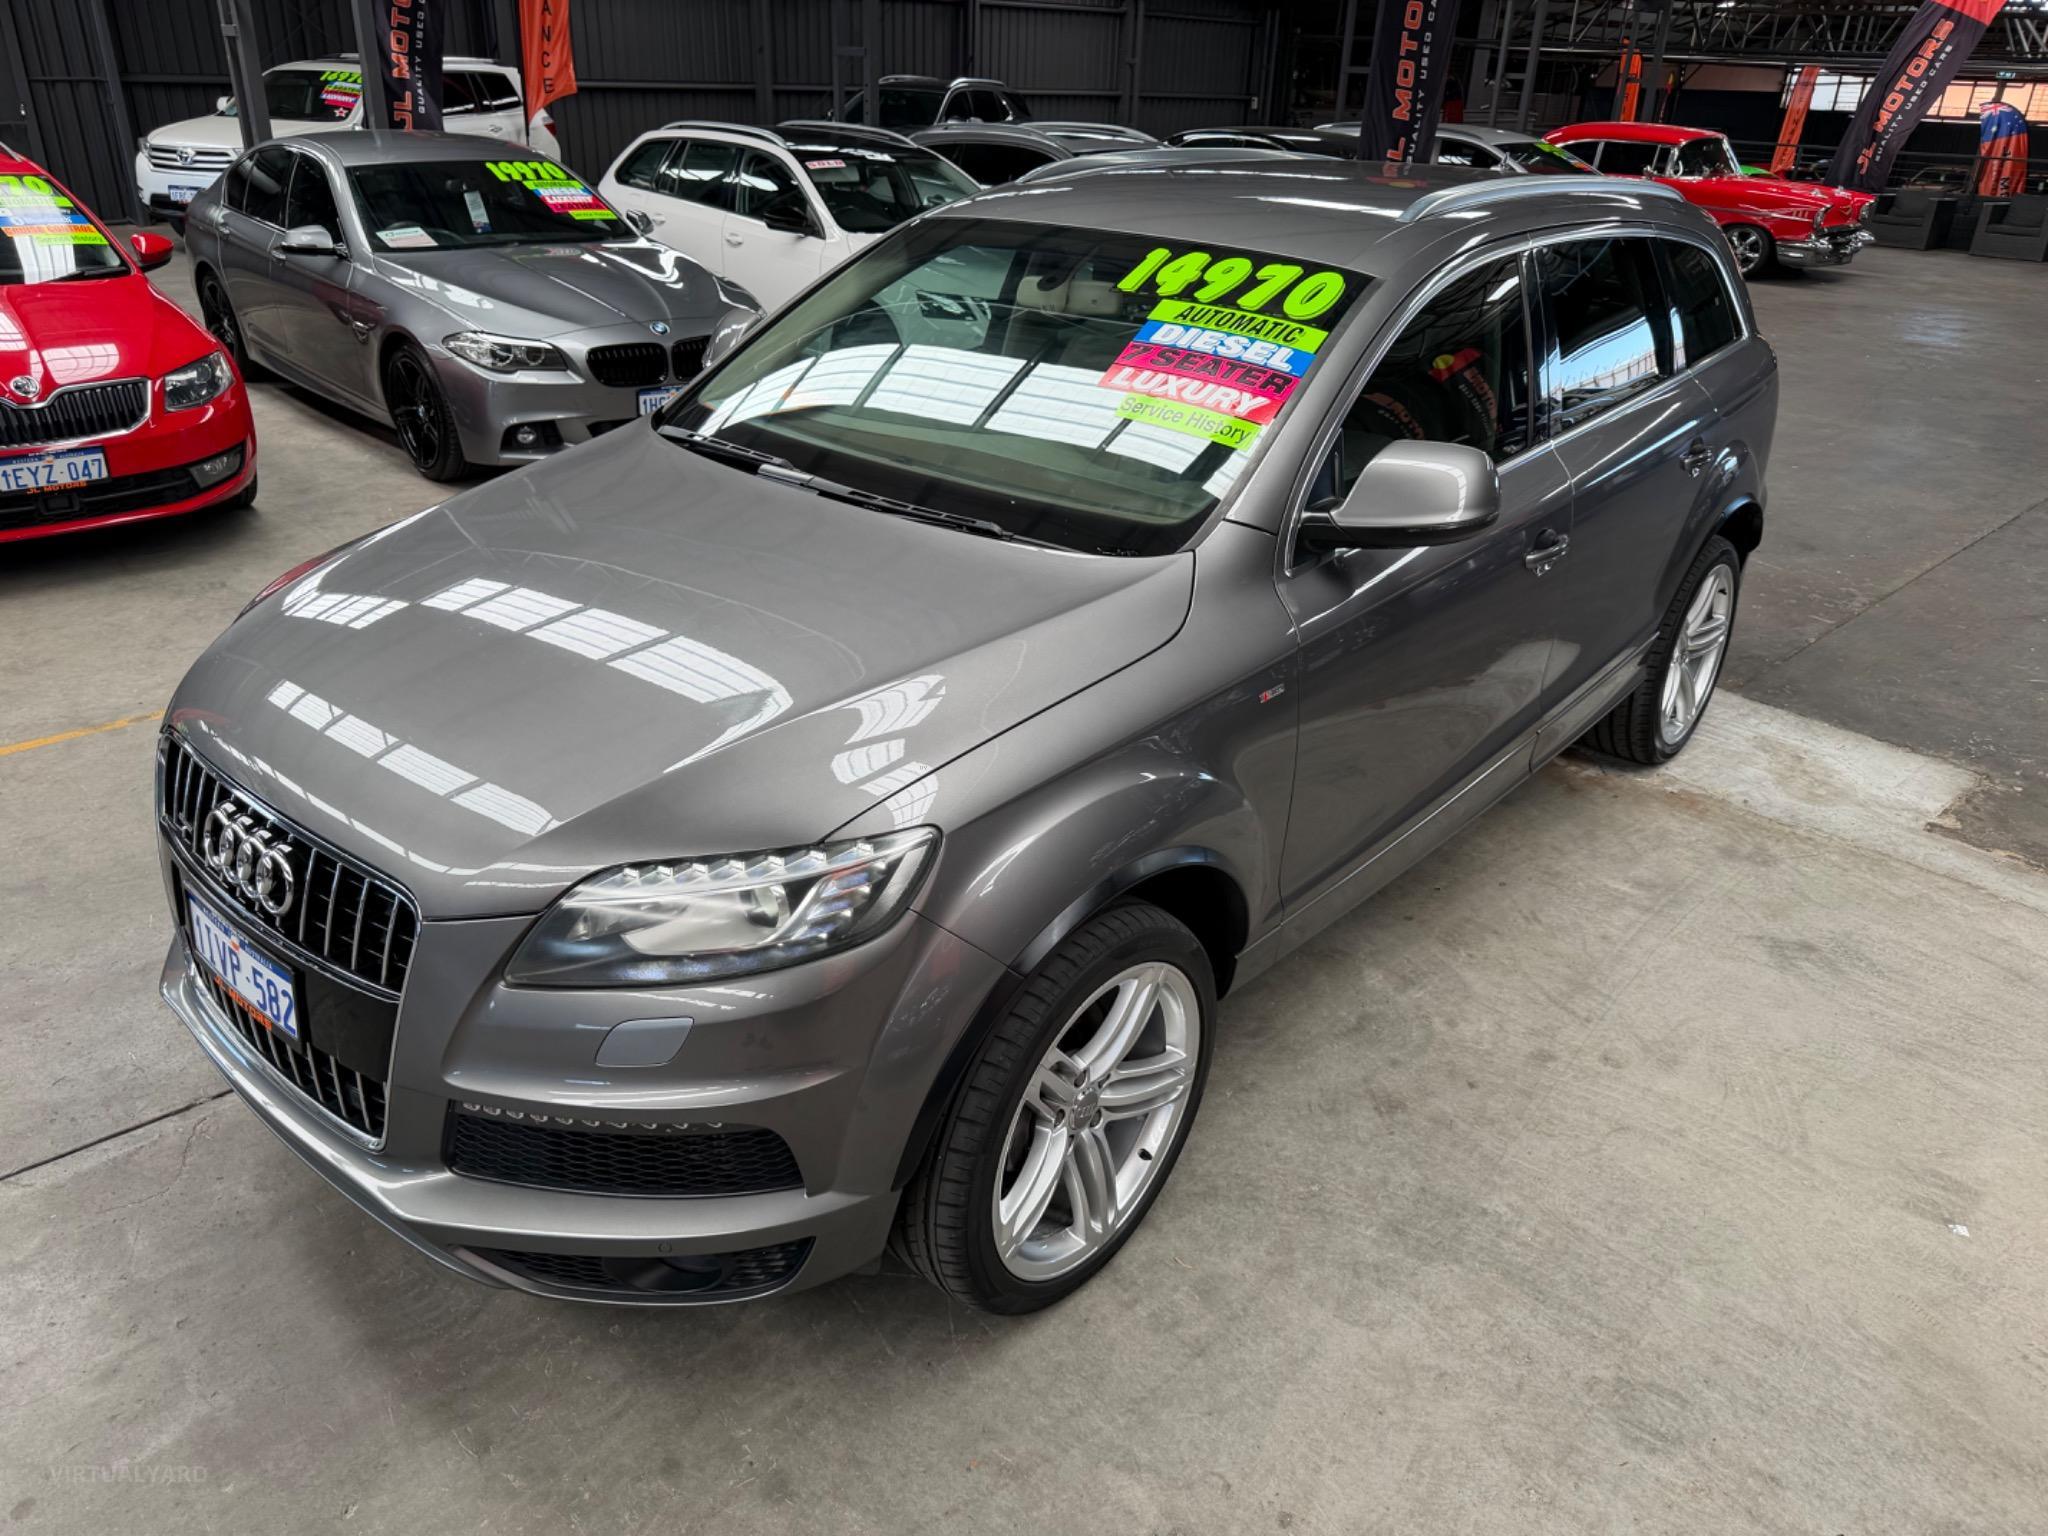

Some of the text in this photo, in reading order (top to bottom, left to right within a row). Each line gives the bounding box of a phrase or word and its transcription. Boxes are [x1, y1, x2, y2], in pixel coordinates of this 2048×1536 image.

[415, 11, 426, 114] QUALITY USED
[1420, 32, 1432, 79] USED
[1856, 17, 1955, 175] JL MOTORS
[1874, 115, 1903, 162] QUALITY
[1929, 44, 1953, 77] CARS
[485, 161, 567, 182] 19970
[1117, 248, 1345, 320] 14970
[1150, 324, 1293, 371] DIESEL
[1173, 305, 1305, 344] AUTOMATIC
[1110, 367, 1274, 415] LUXURY
[1122, 343, 1293, 395] 7 SEATER
[1120, 397, 1252, 443] Service History
